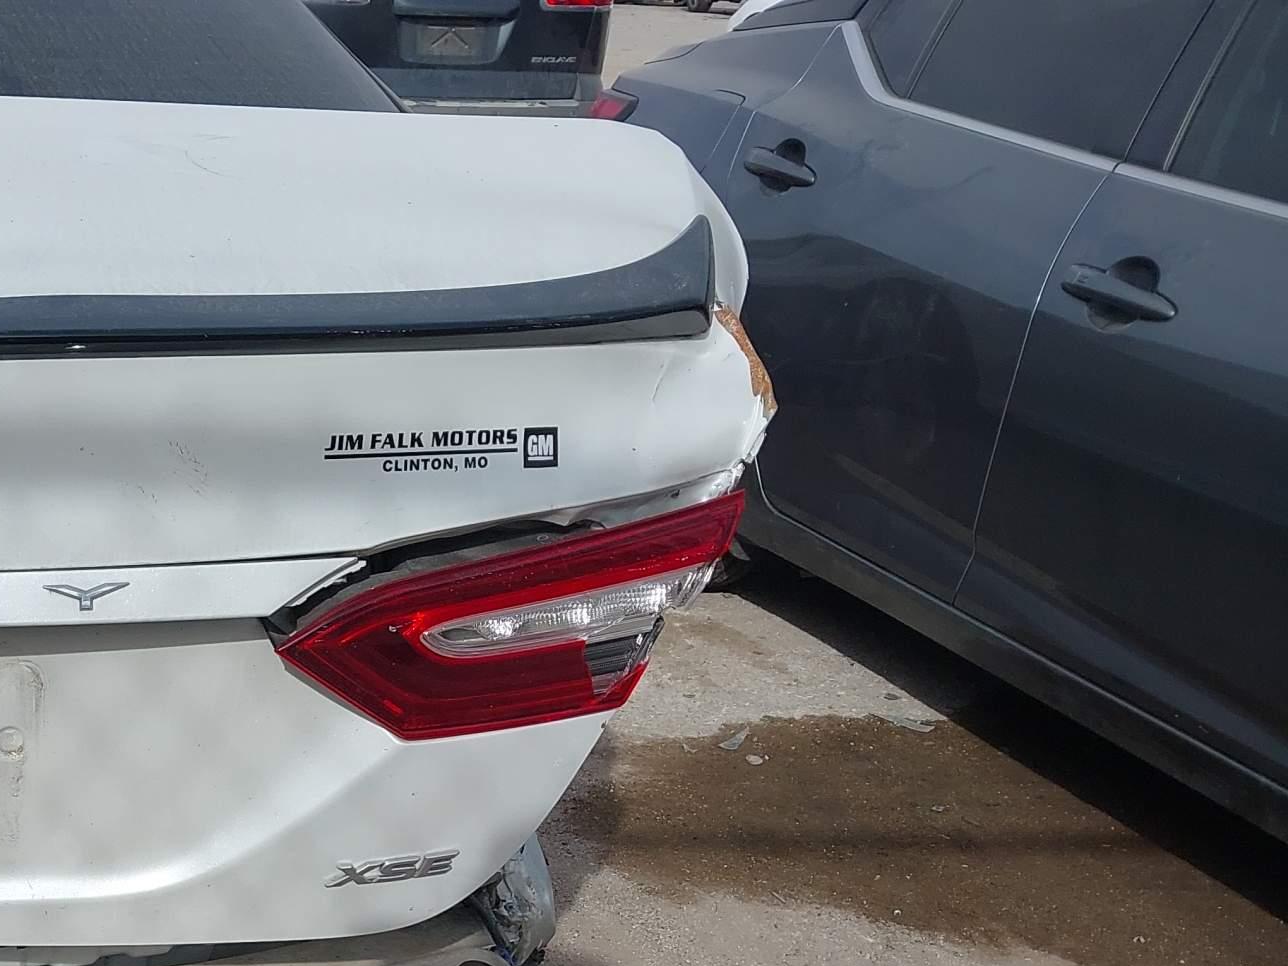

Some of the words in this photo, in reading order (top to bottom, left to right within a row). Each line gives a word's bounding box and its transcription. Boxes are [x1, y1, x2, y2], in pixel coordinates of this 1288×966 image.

[325, 435, 363, 450] JIM
[370, 432, 424, 449] FALK
[431, 428, 518, 447] MOTORS
[527, 434, 554, 457] GM
[382, 457, 459, 472] CLINTON,
[464, 456, 488, 469] MO
[324, 850, 460, 888] XSE
